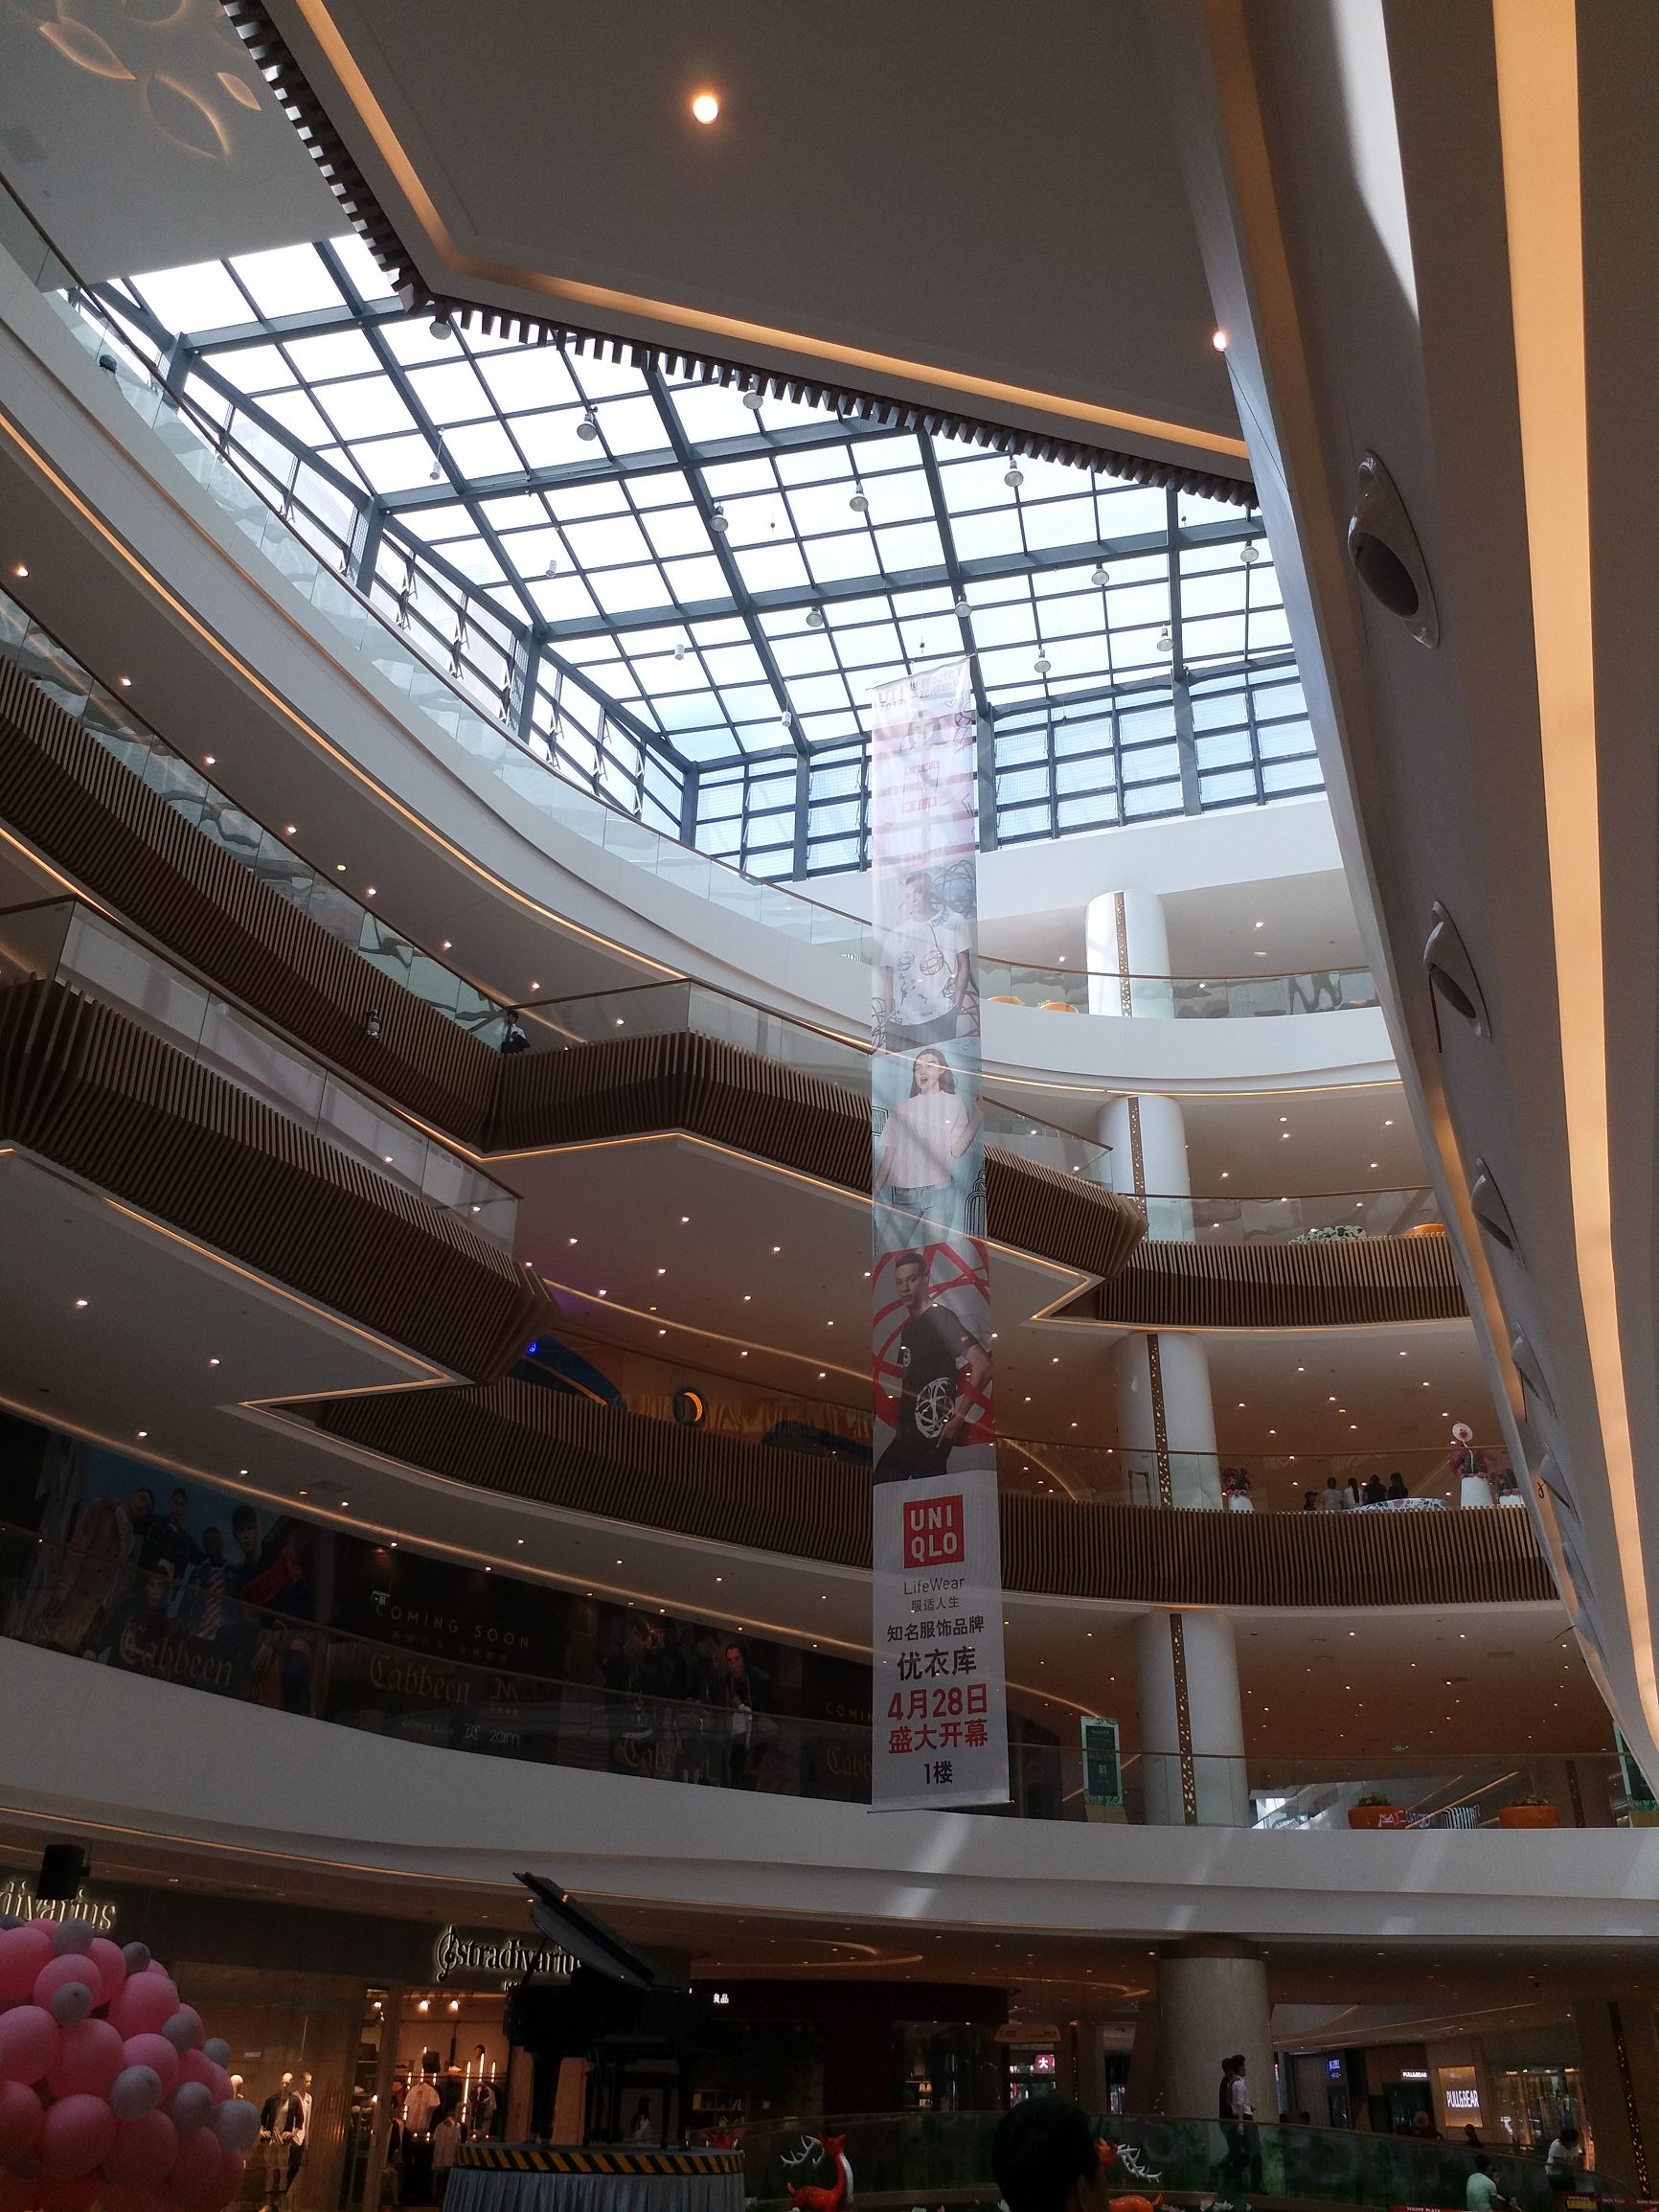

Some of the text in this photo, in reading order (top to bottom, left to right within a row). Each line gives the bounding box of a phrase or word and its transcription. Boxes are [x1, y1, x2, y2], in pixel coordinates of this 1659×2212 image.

[910, 1503, 953, 1532] UNI
[910, 1532, 959, 1563] QLO
[904, 1577, 966, 1596] LifeWear
[911, 1596, 960, 1612] 服适人生
[474, 1625, 530, 1649] SOON
[887, 1614, 986, 1643] 知名服饰品牌
[897, 1645, 977, 1681] 优衣库
[887, 1683, 989, 1722] 4月28日
[888, 1718, 989, 1755] 盛大开幕
[923, 1760, 954, 1785] 1楼
[1445, 2089, 1480, 2109] PULL&BEAR
